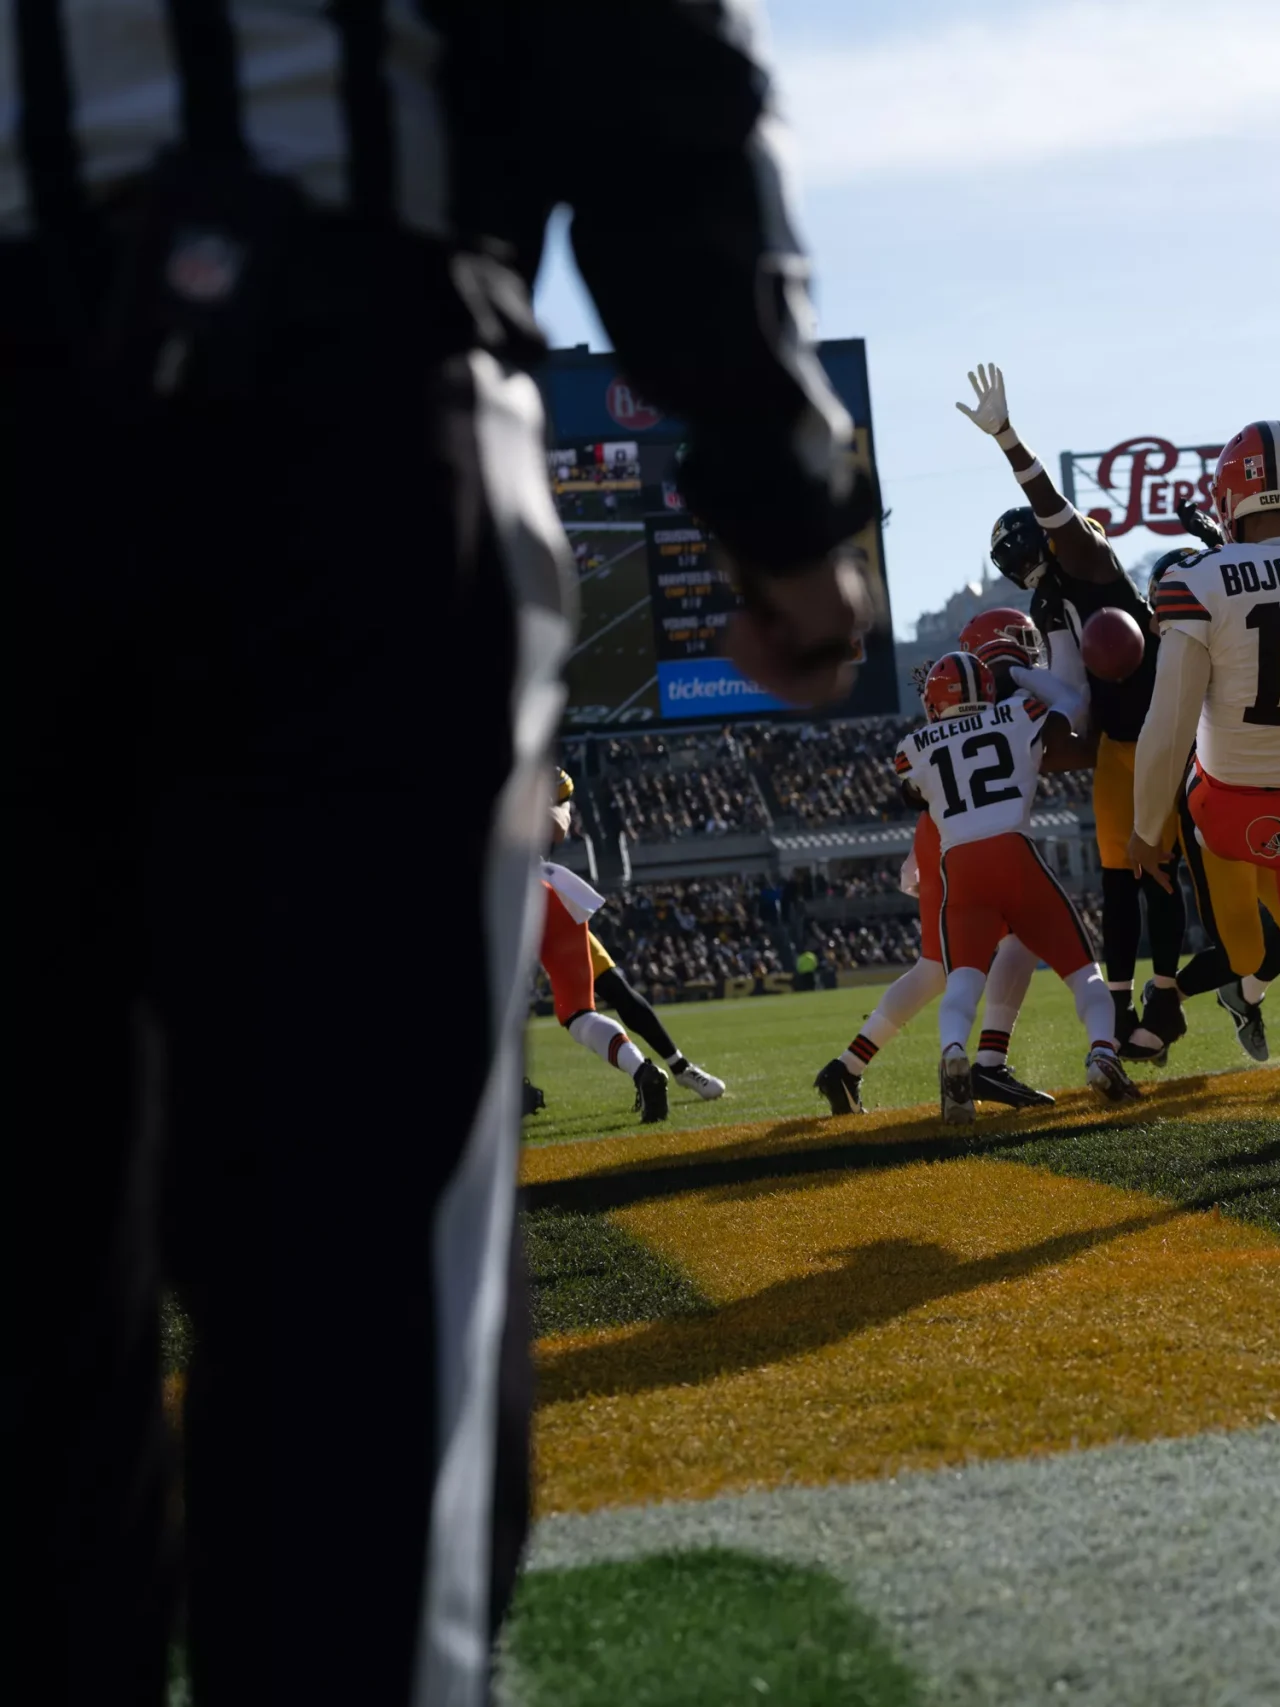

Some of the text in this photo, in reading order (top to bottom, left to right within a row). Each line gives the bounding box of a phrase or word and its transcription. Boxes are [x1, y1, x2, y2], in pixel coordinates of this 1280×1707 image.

[913, 704, 1014, 752] McLEOD JR
[929, 731, 1022, 819] 12
